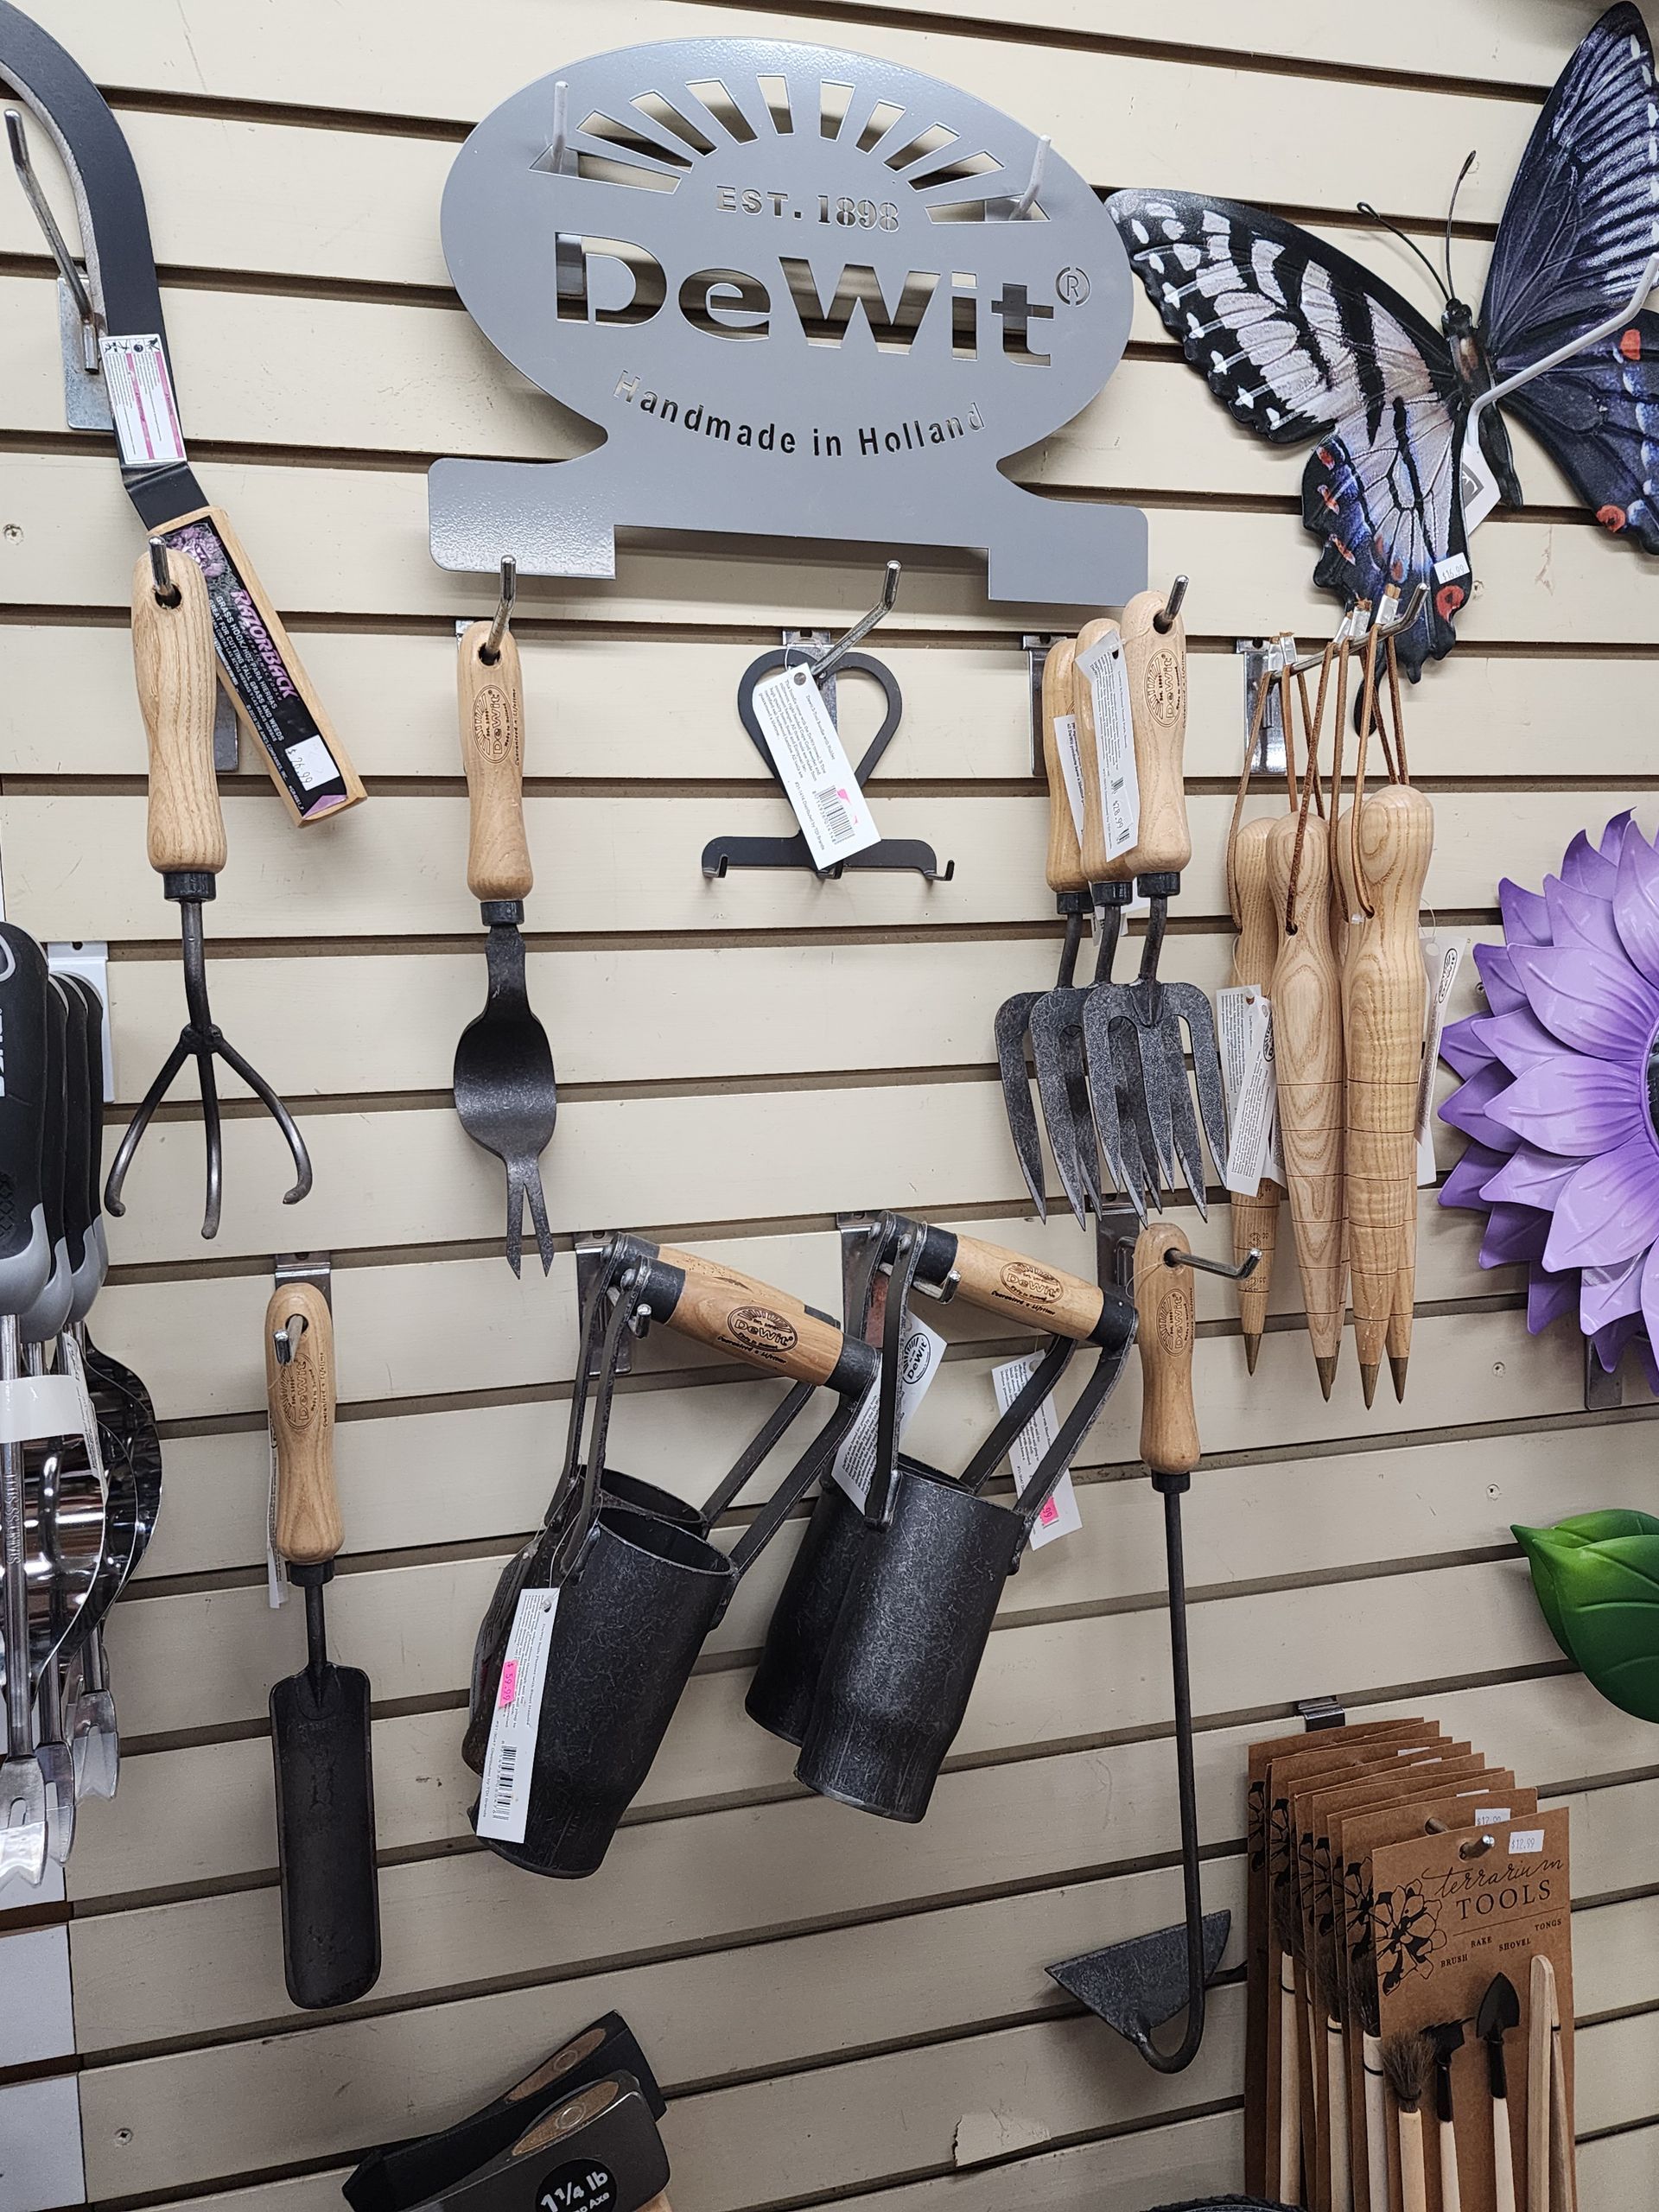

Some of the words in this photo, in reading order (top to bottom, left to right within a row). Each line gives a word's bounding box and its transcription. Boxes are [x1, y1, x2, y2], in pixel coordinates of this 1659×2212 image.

[716, 185, 802, 219] EST.
[817, 194, 899, 232] 1898
[613, 369, 796, 454] Handmade
[812, 428, 842, 456] in
[859, 401, 986, 455] Holland
[1442, 564, 1465, 582] $16.99
[215, 594, 233, 623] GRASS
[249, 662, 263, 681] PARA
[258, 680, 278, 709] HIERBAS
[207, 599, 222, 621] GREAT
[219, 621, 229, 636] FOR
[226, 634, 244, 664] CUTTING
[240, 664, 252, 681] TALL
[249, 680, 264, 703] GRASS
[261, 702, 272, 718] AND
[268, 717, 283, 741] WEEDS
[904, 1342, 929, 1379] DeWit
[501, 1672, 514, 1700] 59.99
[1511, 1838, 1535, 1849] $12.99
[1421, 1859, 1564, 1898] terrarium
[1456, 1879, 1551, 1920] TOOLS
[1534, 1917, 1562, 1932] TONGS
[1471, 1936, 1492, 1948] RAKE
[1498, 1937, 1531, 1951] SHOVEL
[1440, 1954, 1468, 1968] BRUSH
[586, 2171, 608, 2191] lb
[589, 2192, 610, 2209] Axe
